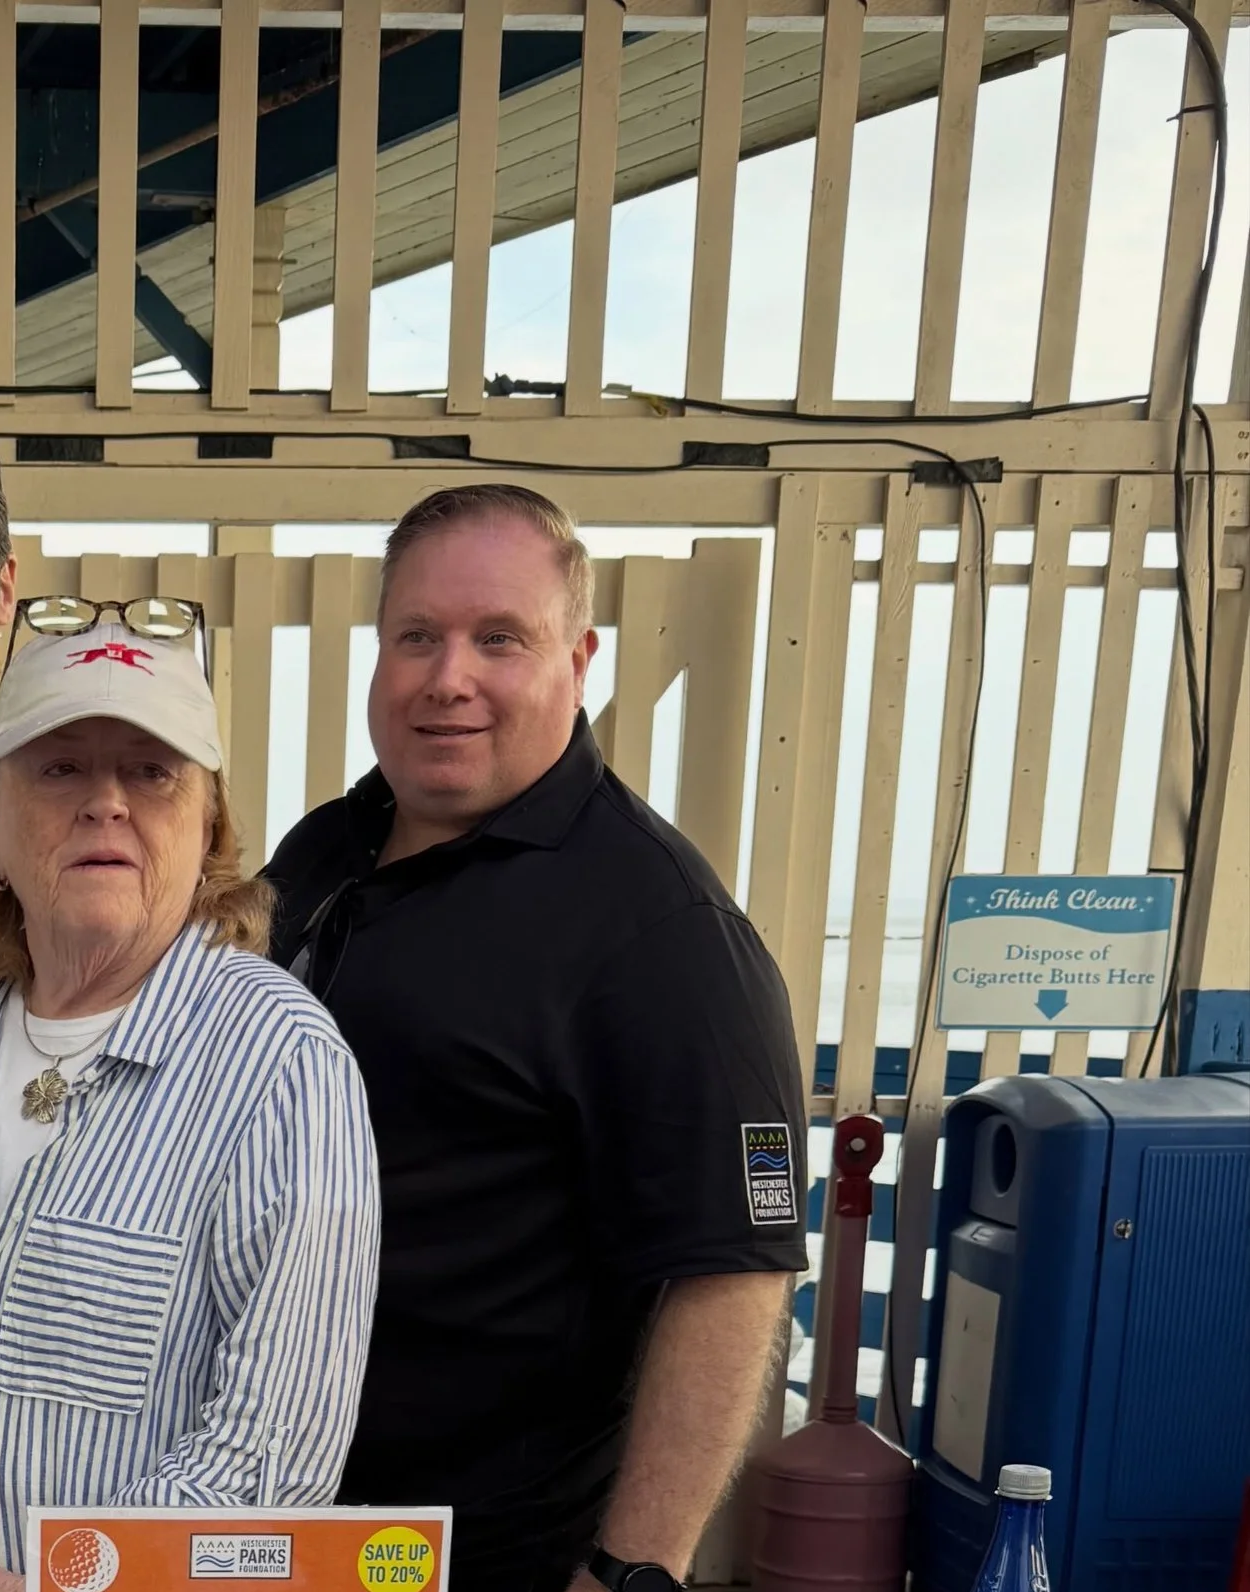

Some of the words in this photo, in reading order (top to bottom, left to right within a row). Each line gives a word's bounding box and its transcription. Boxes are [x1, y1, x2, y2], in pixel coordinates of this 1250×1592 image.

[986, 889, 1059, 910] Think
[1067, 888, 1138, 911] Clean
[1005, 945, 1083, 965] Dispose
[1090, 944, 1112, 960] of
[952, 968, 1043, 988] Cigarette
[1048, 969, 1100, 984] Butts
[1106, 970, 1155, 984] Here
[752, 1180, 788, 1189] WESTCHESTER
[753, 1189, 790, 1207] PARKS
[755, 1207, 791, 1218] FOUNDATION
[240, 1539, 287, 1548] WESTCHESTER
[239, 1549, 286, 1564] PARKS
[365, 1544, 403, 1561] SAVE
[407, 1544, 429, 1560] UP
[239, 1565, 286, 1574] FOUNDATION
[368, 1567, 385, 1583] TO
[390, 1566, 424, 1583] 20%
